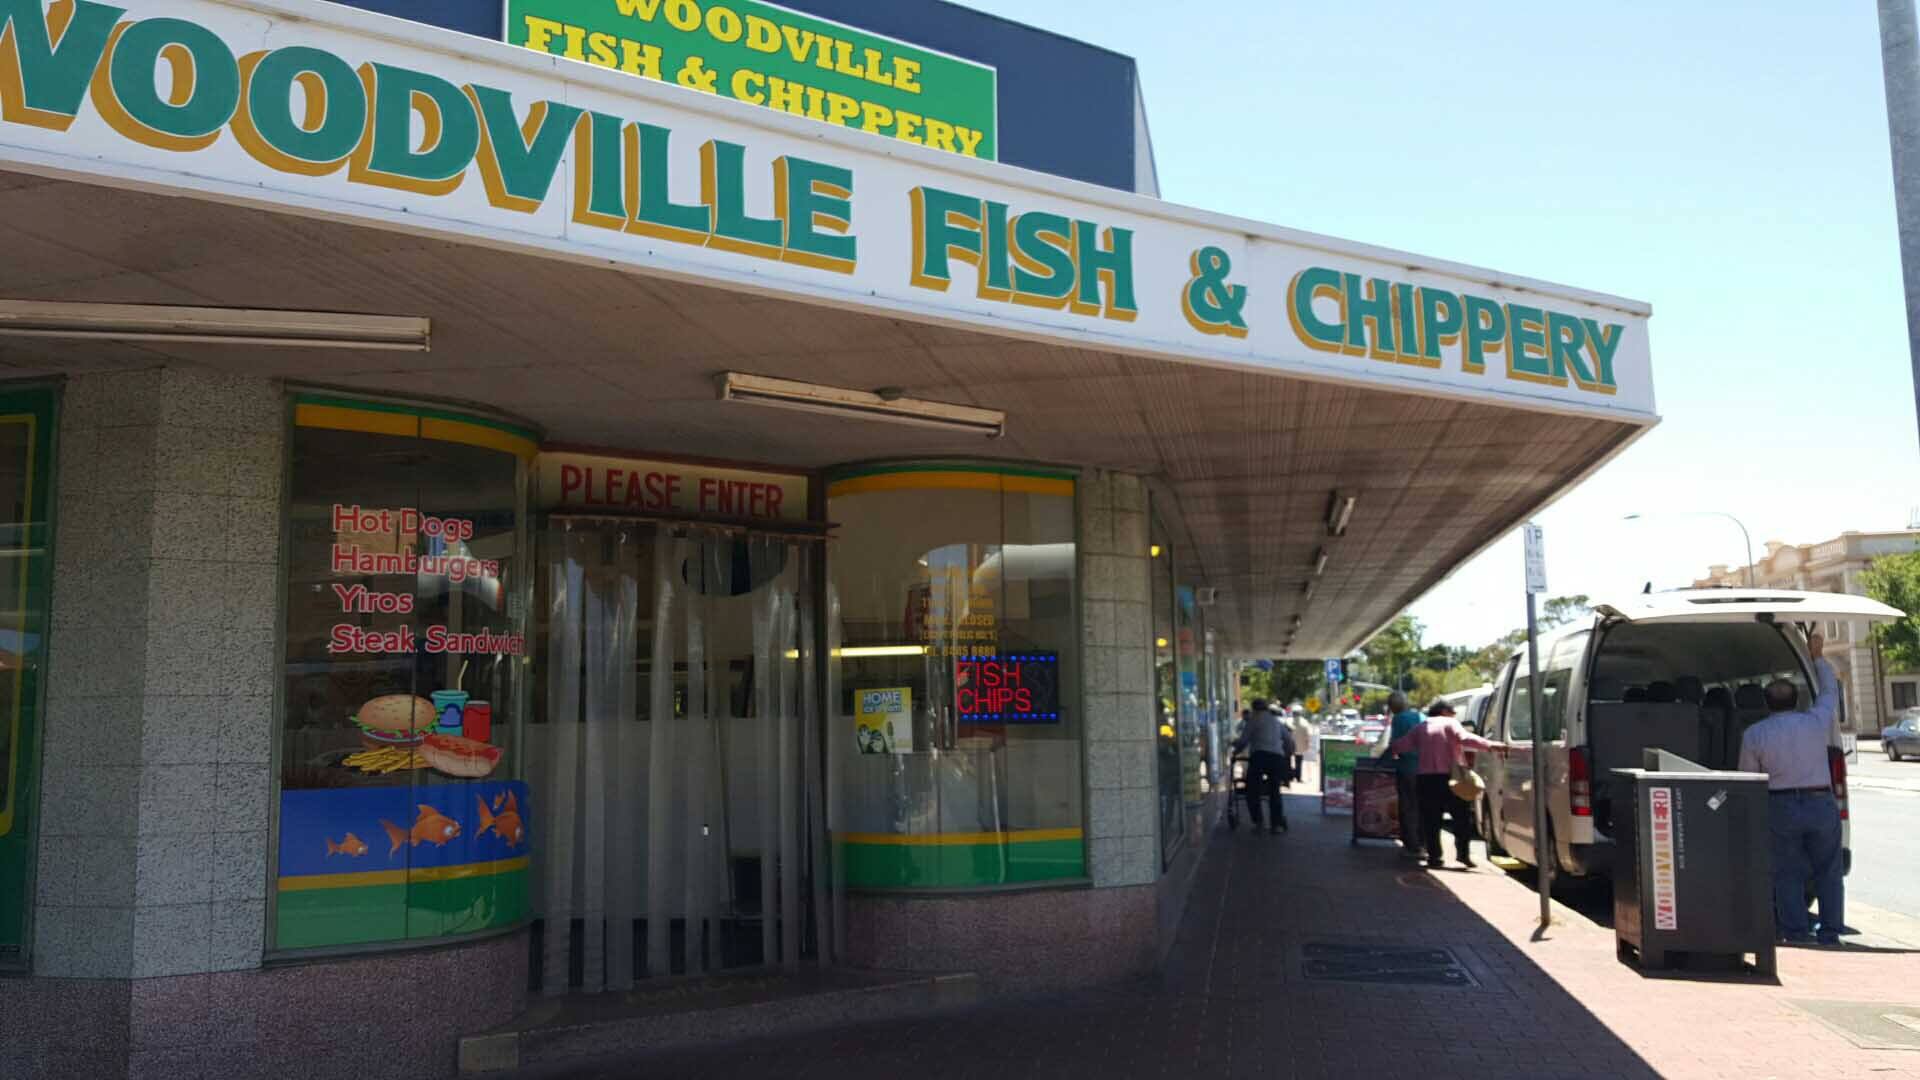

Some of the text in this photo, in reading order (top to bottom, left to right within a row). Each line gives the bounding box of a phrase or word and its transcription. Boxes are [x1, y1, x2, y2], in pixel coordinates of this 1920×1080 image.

[614, 0, 922, 94] WOODVILLE
[524, 15, 983, 158] FISH & CHIPPERY
[910, 185, 1138, 321] FISH
[1182, 246, 1248, 339] &
[1287, 266, 1624, 395] CHIPPERY
[560, 464, 785, 519] PLEASE ENTER
[333, 504, 474, 544] Hot Dogs
[332, 543, 500, 584] Hamburgers
[332, 583, 414, 613] Yiros
[330, 623, 415, 653] Steak
[956, 661, 1022, 687] FISH
[863, 692, 901, 704] HOME
[957, 688, 1032, 713] CHIPS
